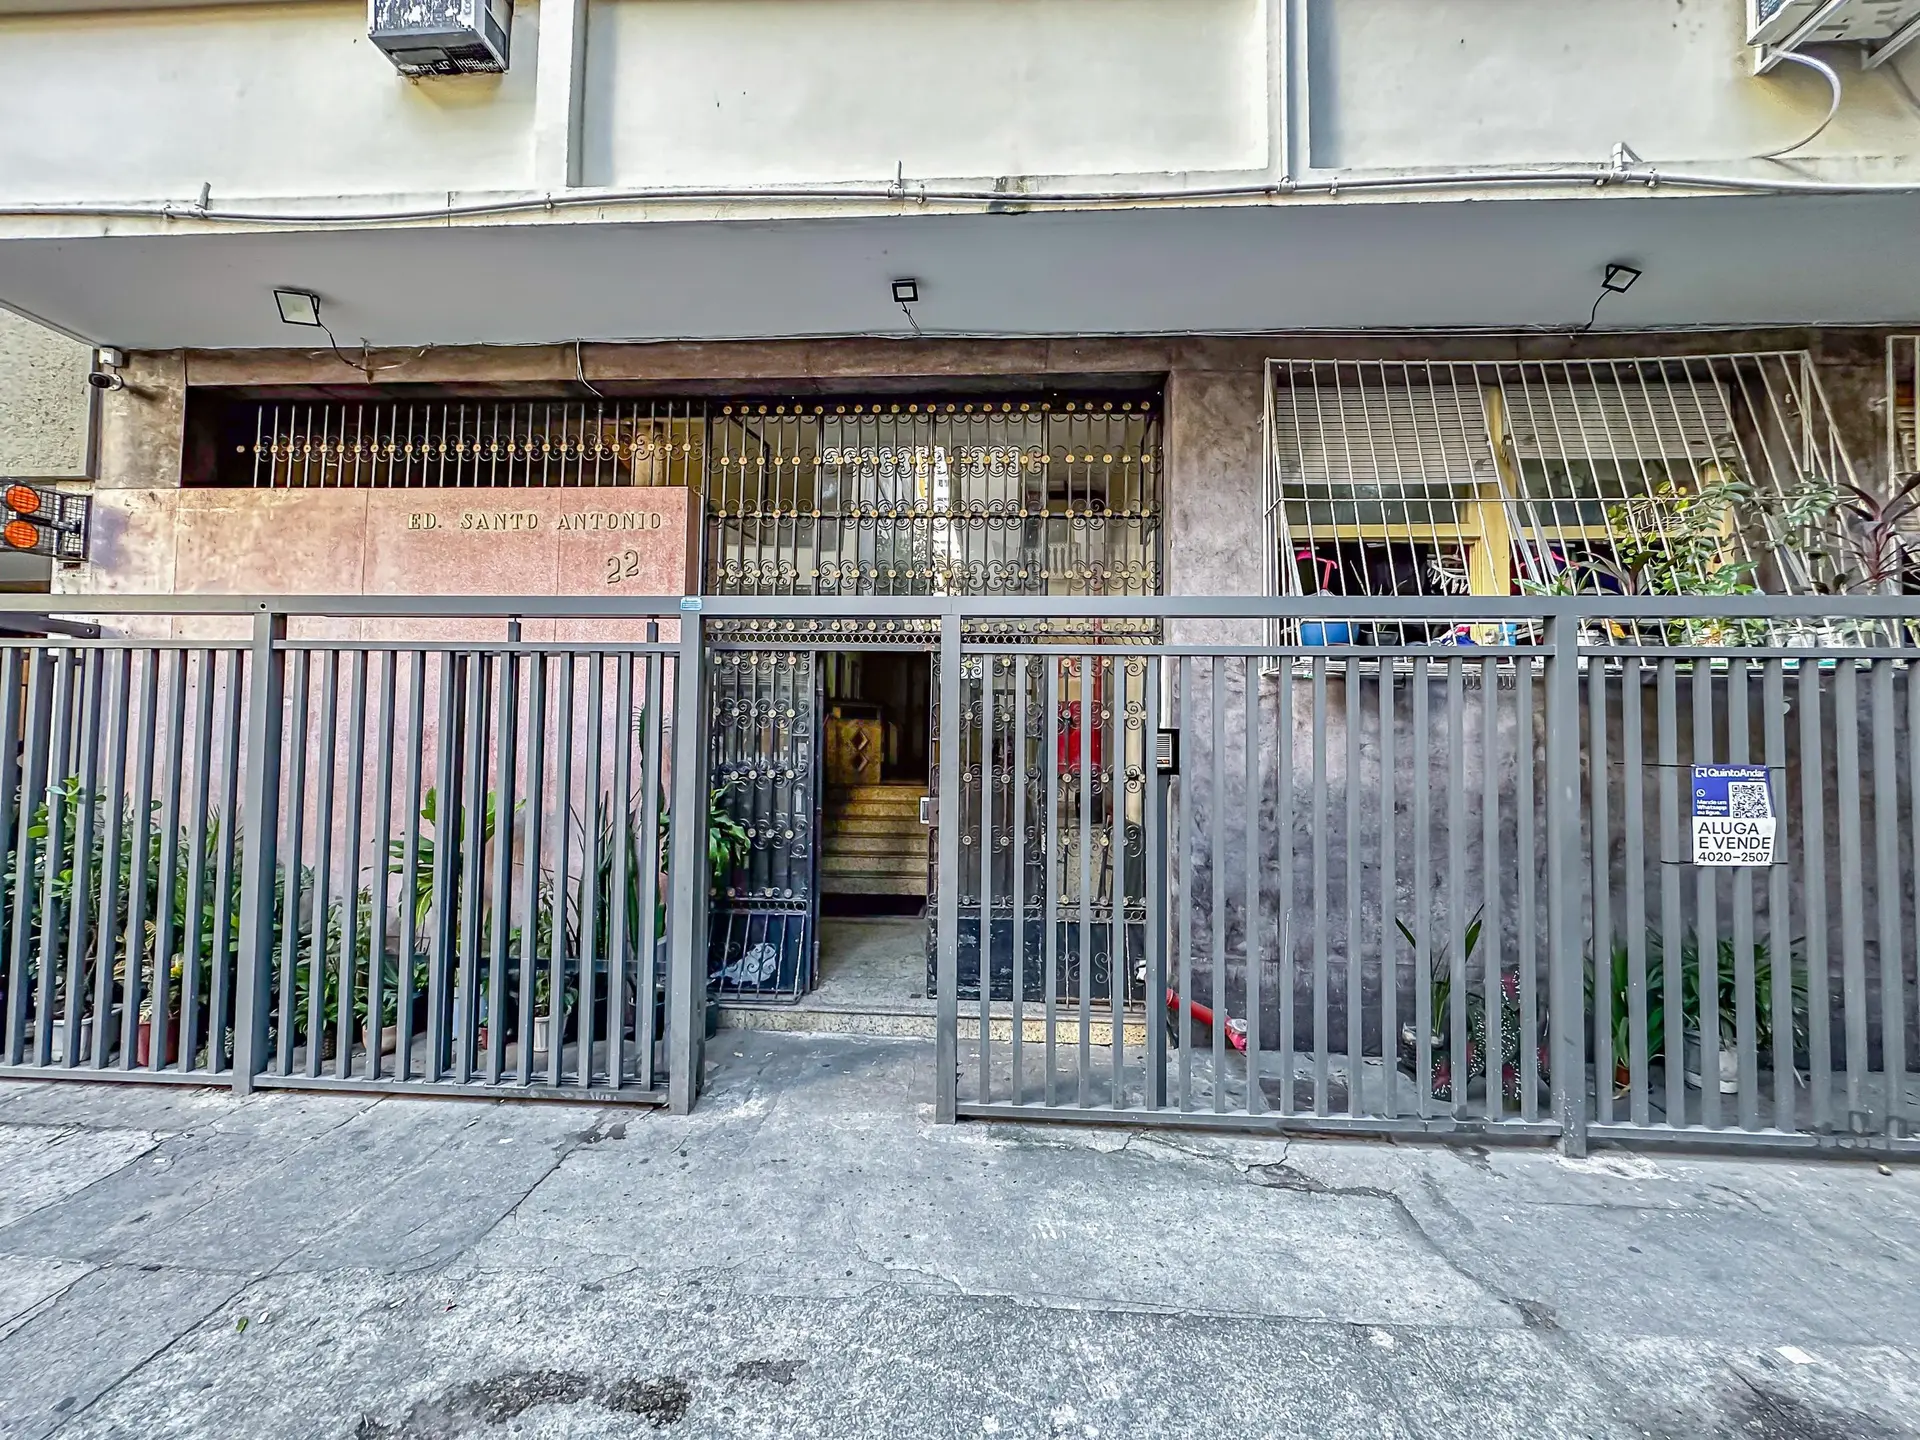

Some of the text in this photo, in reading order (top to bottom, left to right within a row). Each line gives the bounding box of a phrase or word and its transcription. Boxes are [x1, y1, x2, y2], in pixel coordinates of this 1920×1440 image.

[408, 512, 662, 530] ED. SANTO ANTONIO
[606, 549, 640, 584] 22
[1708, 768, 1766, 777] QuintoAndar
[1698, 822, 1759, 835] ALUGA
[1699, 837, 1771, 849] E VENDE
[1698, 852, 1770, 862] 4020-2507
